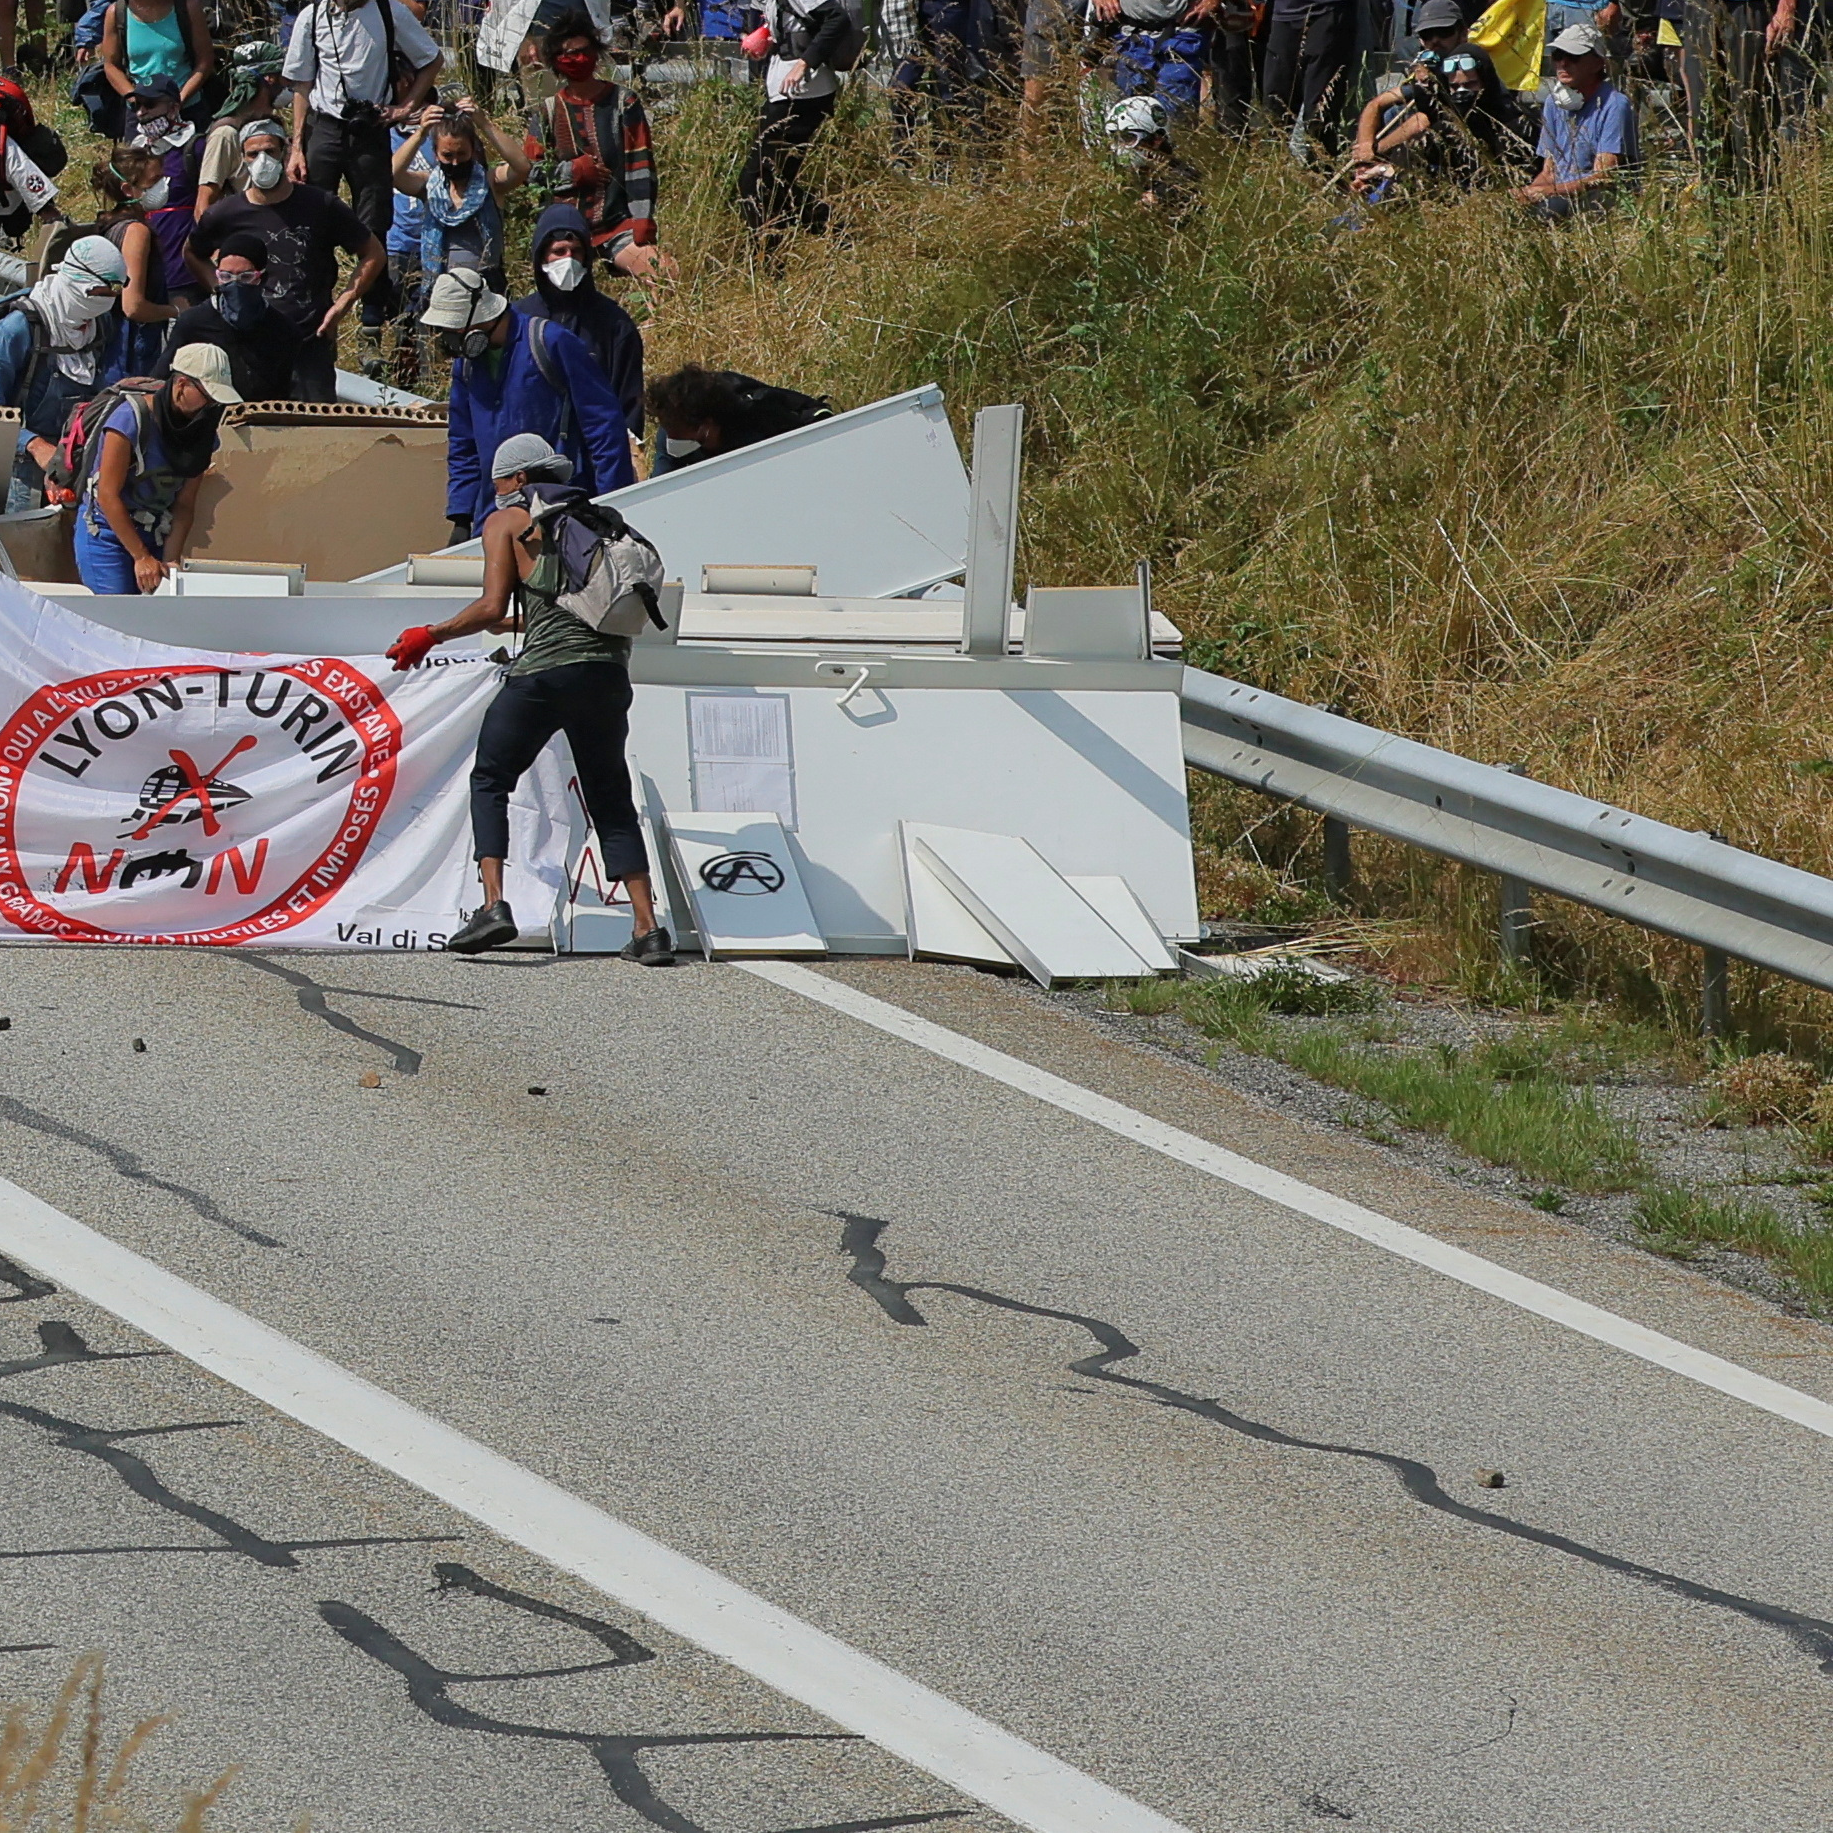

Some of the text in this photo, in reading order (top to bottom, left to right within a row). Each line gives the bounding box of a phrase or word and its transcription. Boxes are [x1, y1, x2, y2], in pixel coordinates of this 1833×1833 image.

[3, 723, 39, 762] OUI
[33, 709, 54, 729] A
[38, 670, 360, 785] LYON-TURIN
[286, 884, 316, 913] ET
[311, 786, 380, 888] IMPOSÉS
[337, 923, 382, 946] Val
[392, 929, 418, 950] di
